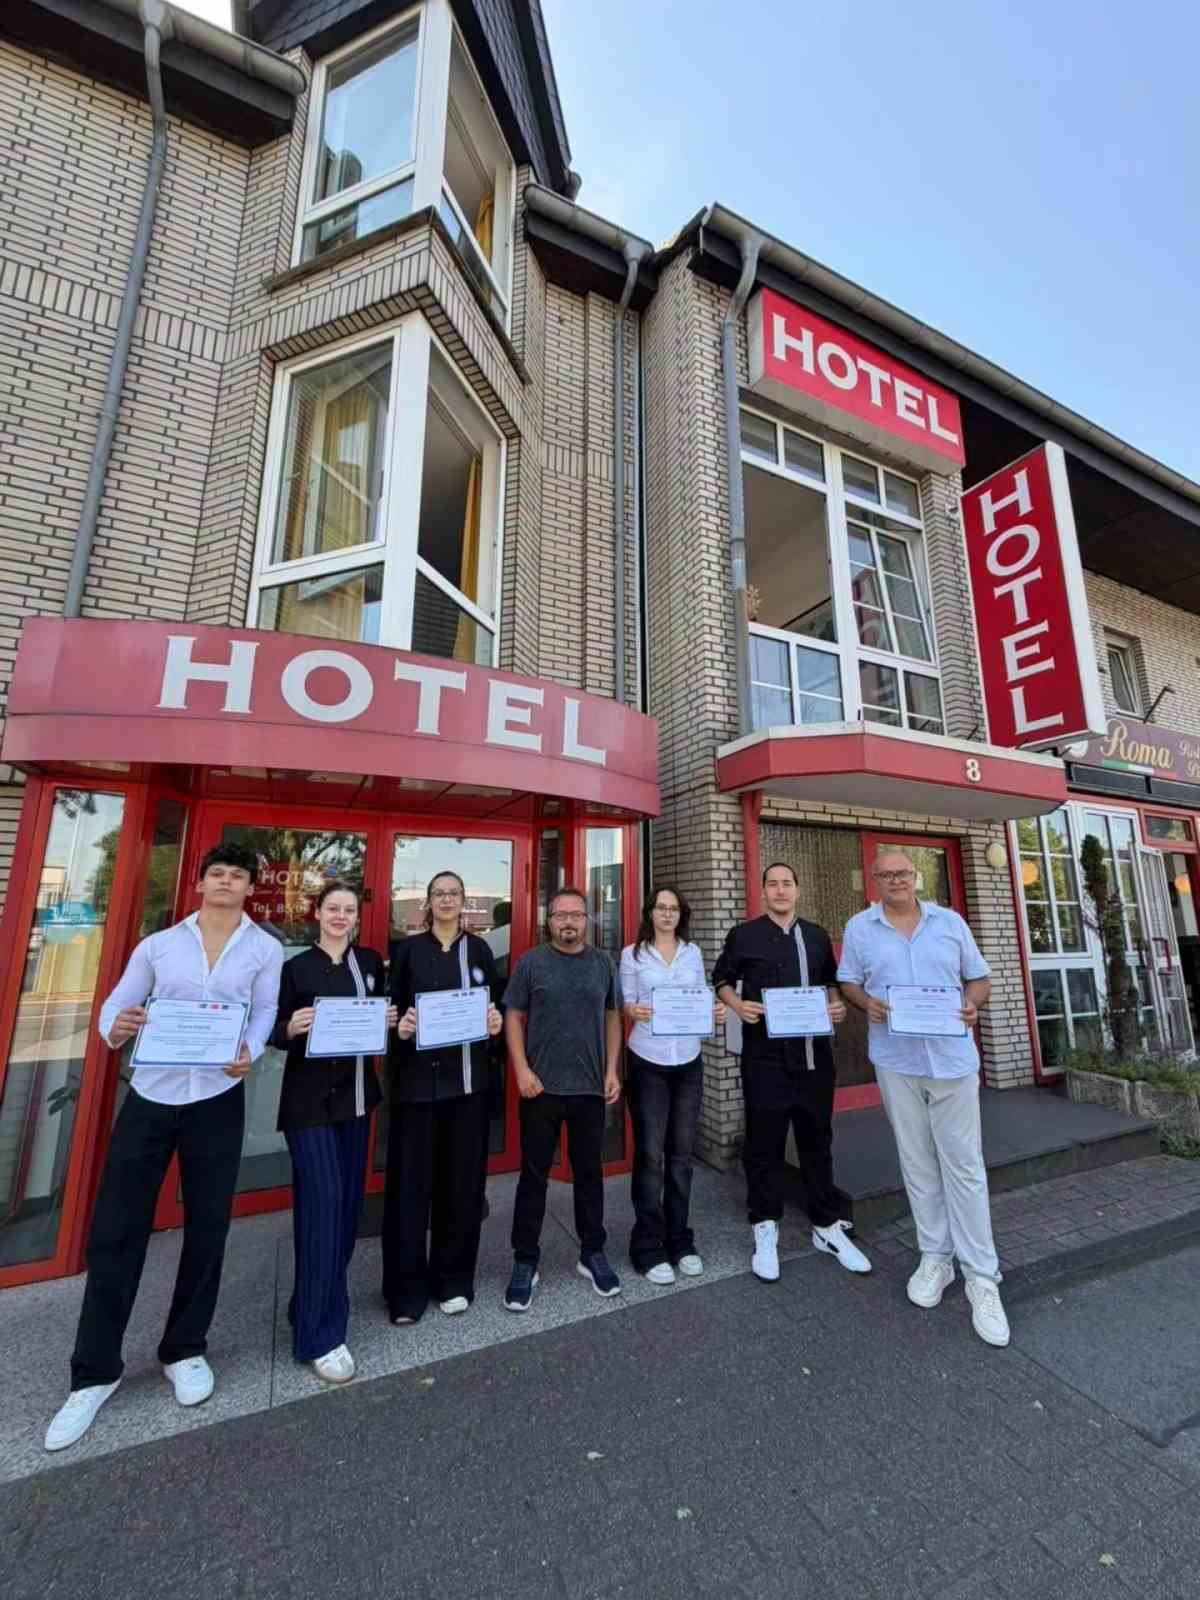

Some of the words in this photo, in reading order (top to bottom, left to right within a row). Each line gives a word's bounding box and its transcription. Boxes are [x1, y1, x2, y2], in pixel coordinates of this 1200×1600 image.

[771, 312, 959, 444] HOTEL
[978, 467, 1065, 736] HOTEL
[157, 634, 608, 766] HOTEL
[1100, 718, 1174, 768] Roma
[965, 758, 982, 782] 8
